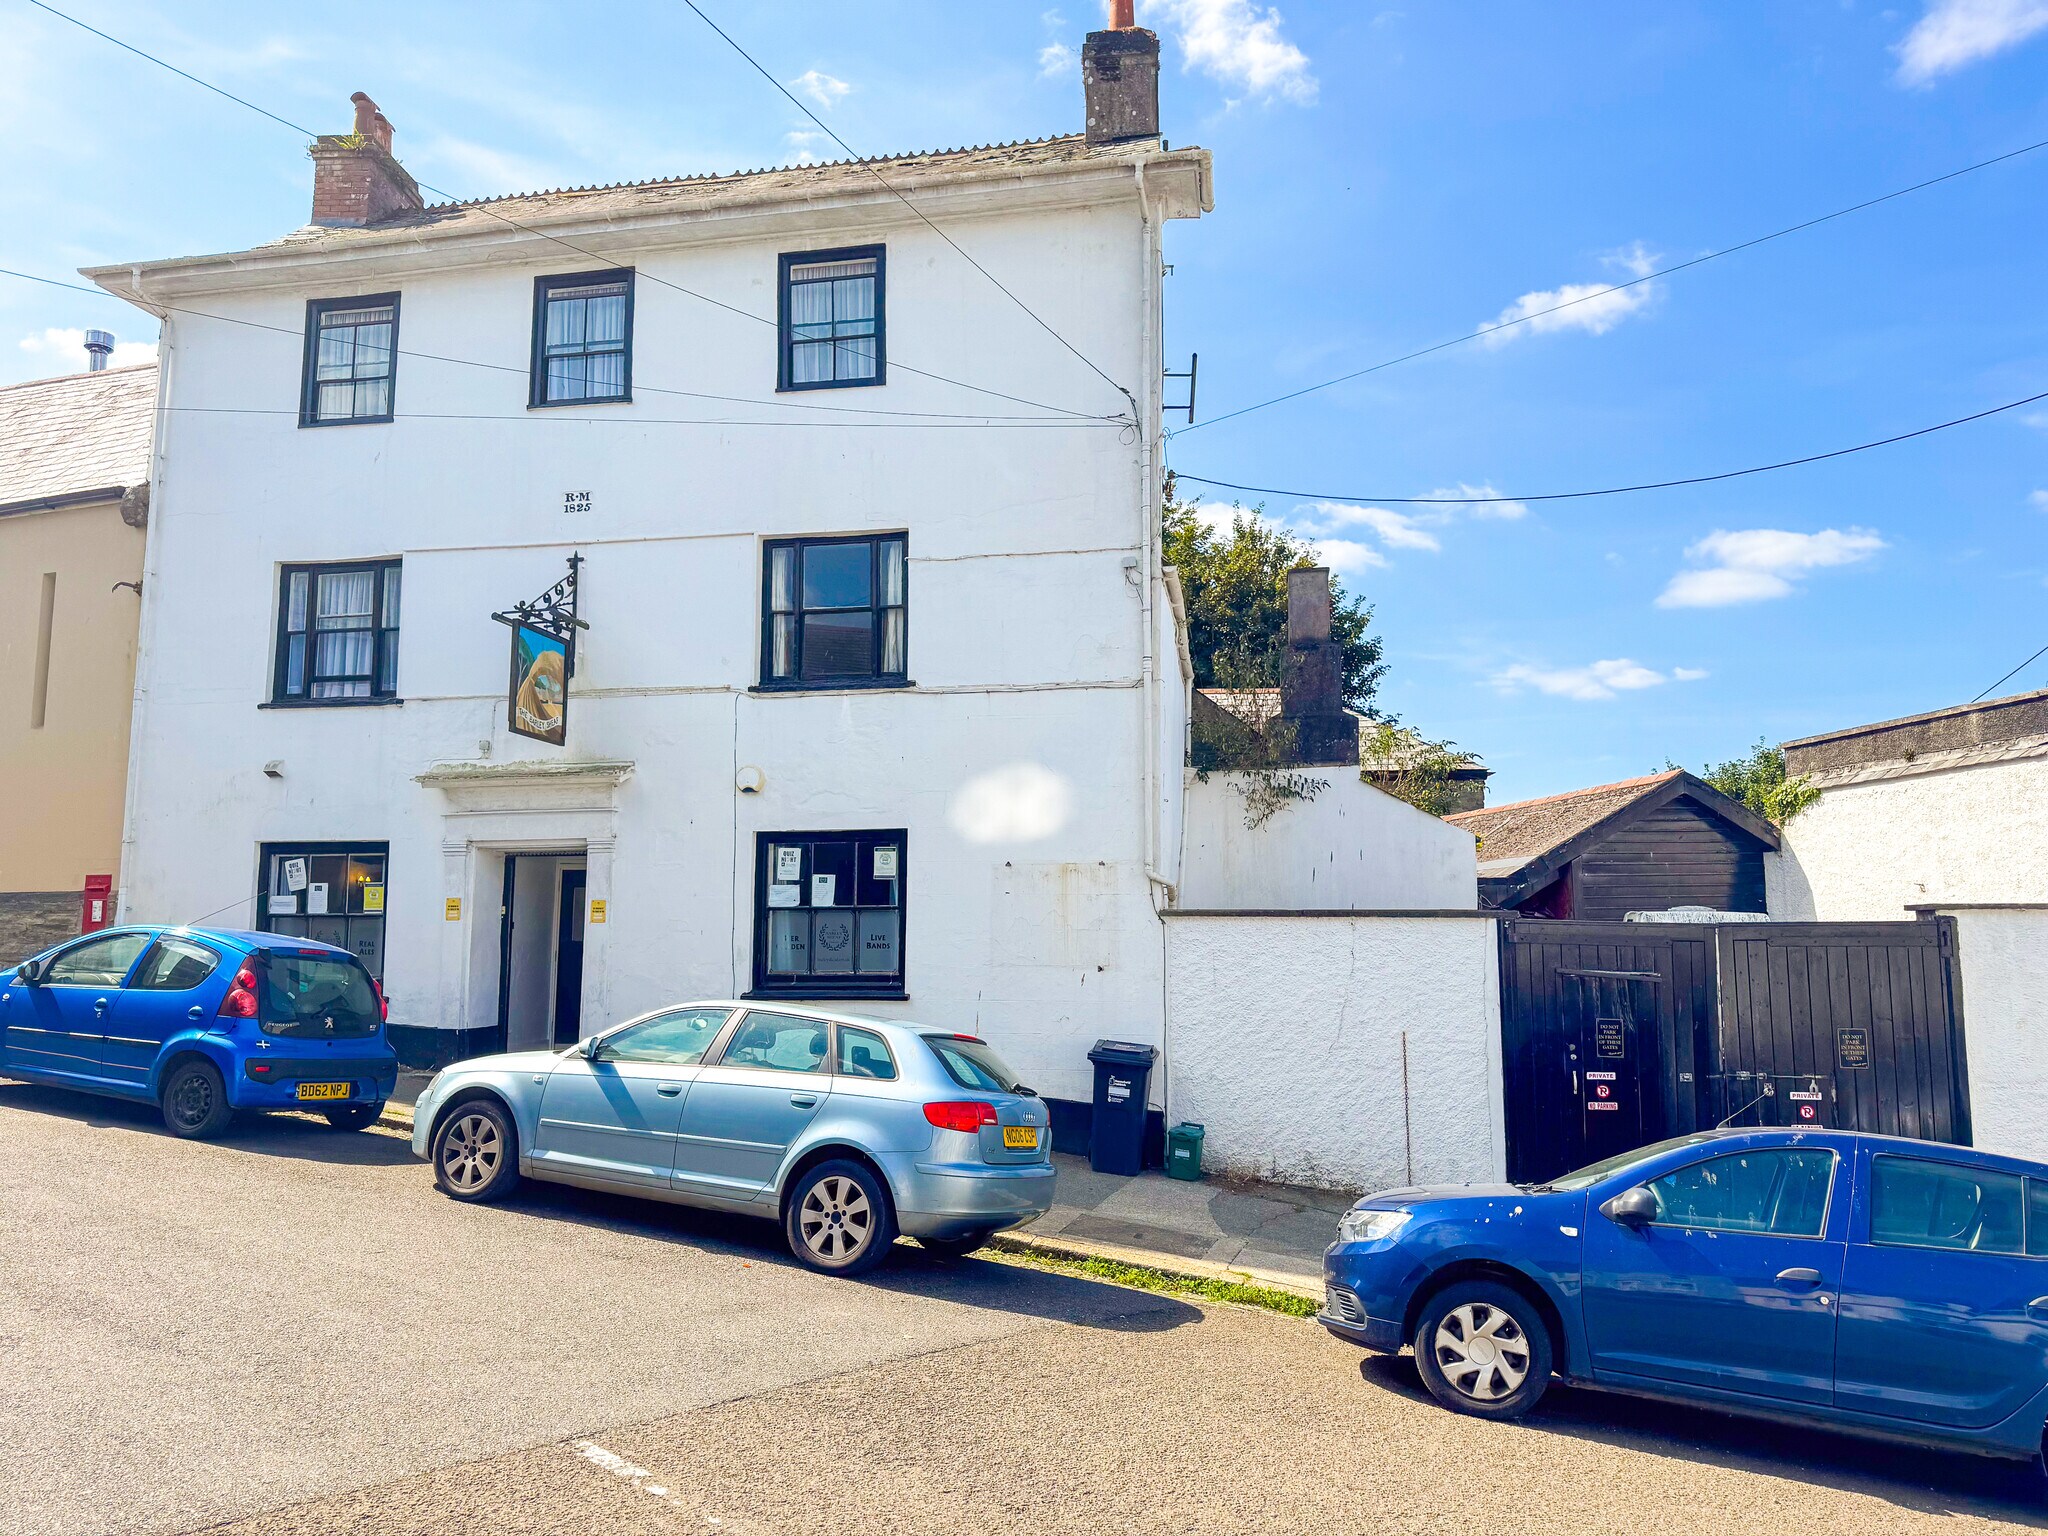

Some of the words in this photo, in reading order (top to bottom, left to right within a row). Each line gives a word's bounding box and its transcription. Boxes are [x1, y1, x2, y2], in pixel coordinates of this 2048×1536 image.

[564, 503, 592, 513] 1825
[530, 716, 545, 730] BARLEY
[546, 716, 559, 729] SHEAF
[301, 1085, 328, 1097] BD62
[330, 1084, 348, 1096] NPJ
[1005, 1128, 1024, 1143] NG06
